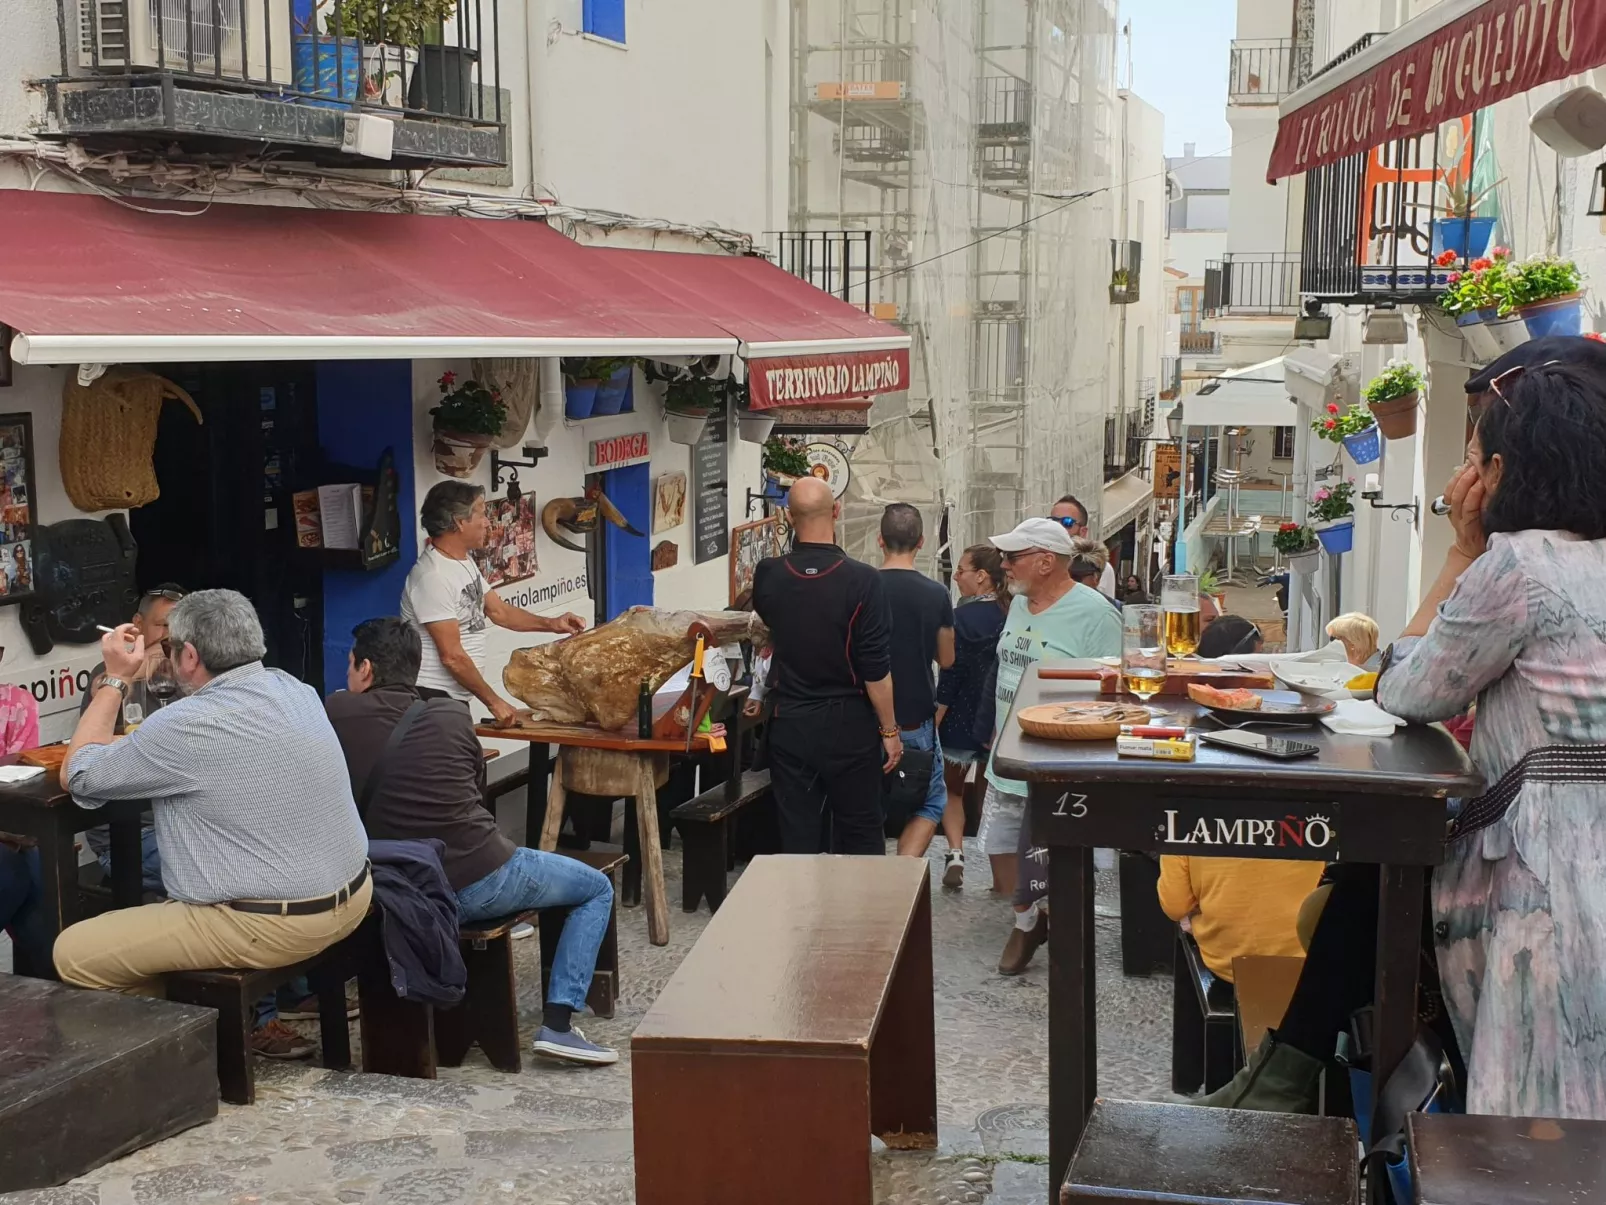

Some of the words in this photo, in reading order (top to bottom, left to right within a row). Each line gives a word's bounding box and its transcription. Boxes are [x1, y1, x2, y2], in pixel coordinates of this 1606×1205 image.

[1386, 62, 1415, 131] DE
[766, 364, 849, 401] TERRITORIO
[852, 355, 899, 393] LAMPIÑO
[595, 431, 648, 467] BODEGA
[1001, 648, 1009, 662] IS
[1015, 636, 1032, 652] SUN
[18, 667, 92, 702] piño
[1052, 791, 1088, 818] 13
[1164, 809, 1331, 848] LAMPIÑO
